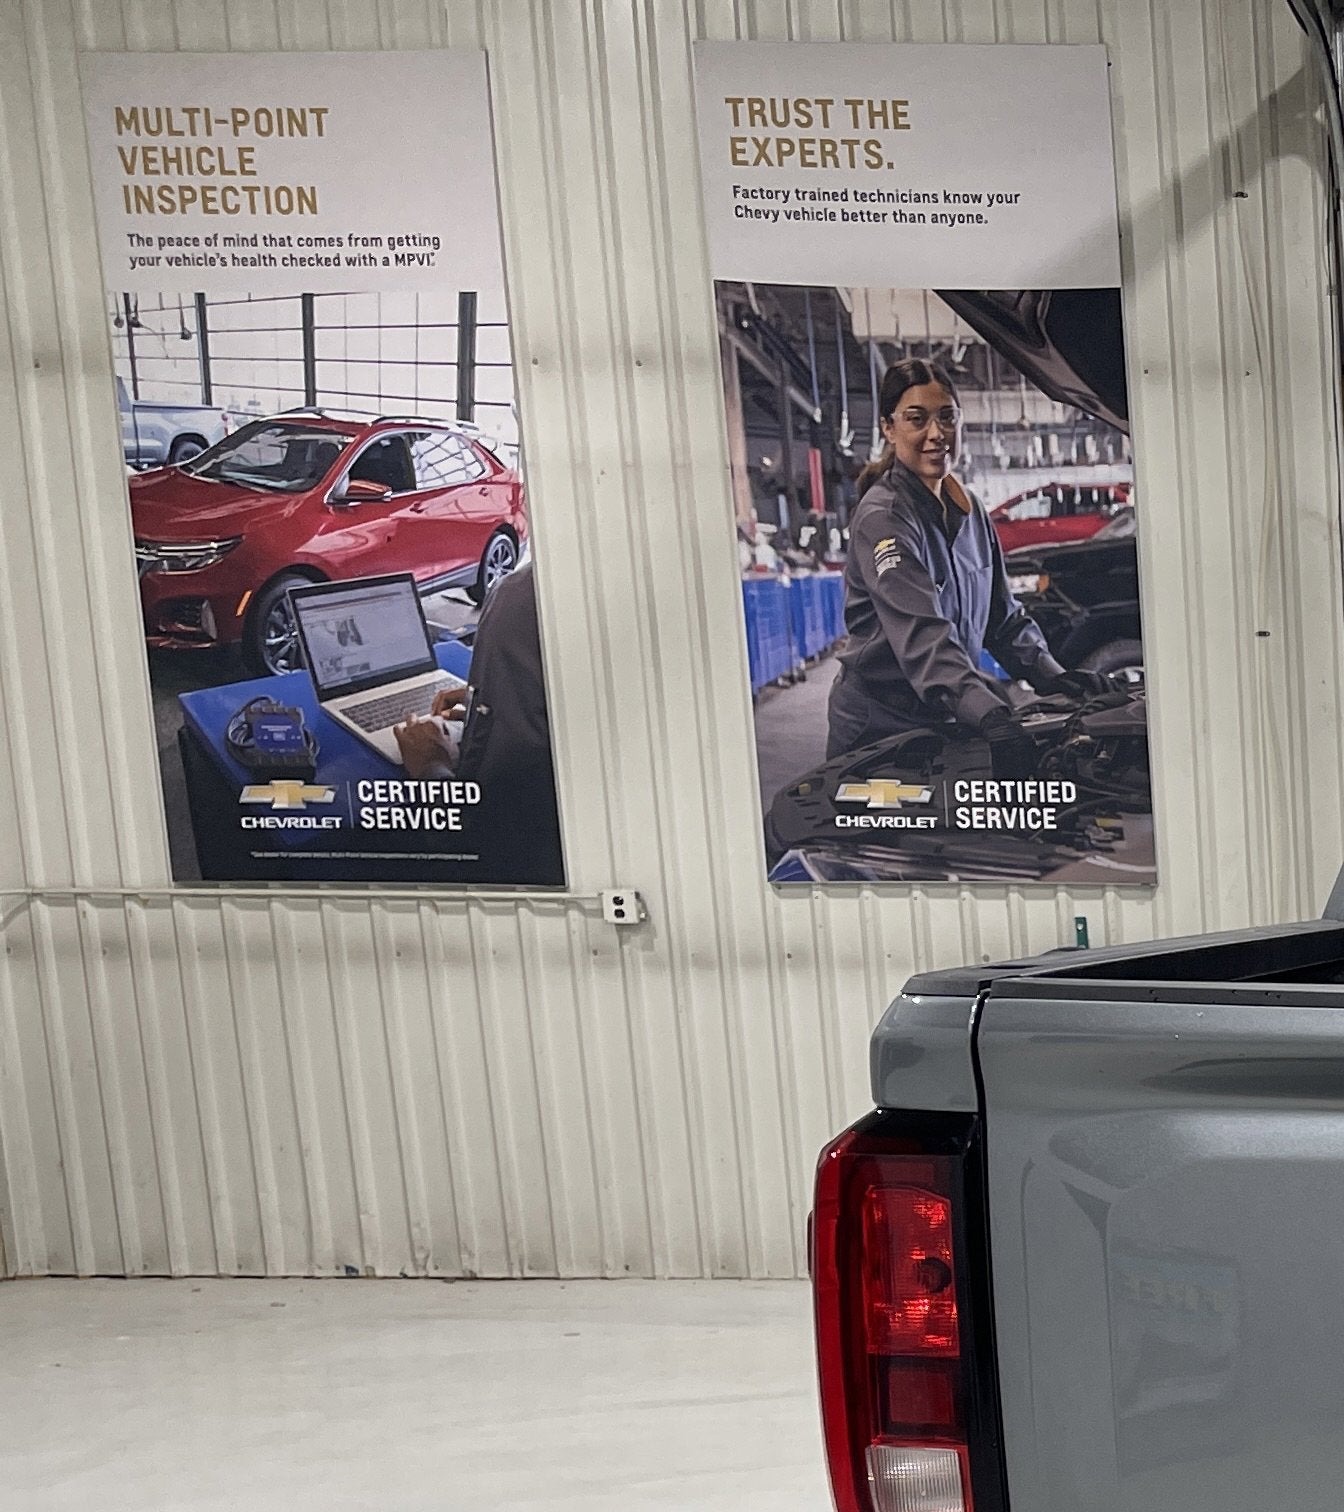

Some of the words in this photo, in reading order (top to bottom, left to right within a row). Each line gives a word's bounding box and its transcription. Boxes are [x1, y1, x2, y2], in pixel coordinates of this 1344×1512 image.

[115, 107, 329, 137] MULTI-POINT
[725, 98, 834, 129] TRUST
[844, 99, 911, 130] THE
[118, 146, 257, 176] VEHICLE
[730, 137, 895, 170] EXPERTS.
[124, 185, 319, 215] INSPECTION
[733, 185, 790, 203] Factory
[795, 187, 849, 202] trained
[853, 188, 939, 204] technicians
[943, 190, 983, 204] know
[986, 191, 1021, 206] your
[734, 205, 779, 223] Chevy
[784, 207, 837, 222] vehicle
[841, 208, 887, 223] better
[892, 209, 926, 224] than
[930, 212, 989, 227] anyone.
[127, 233, 154, 247] The
[158, 235, 200, 250] peace
[204, 233, 218, 247] of
[223, 233, 258, 247] mind
[262, 233, 293, 247] that
[297, 236, 344, 247] comes
[348, 233, 383, 247] from
[387, 233, 440, 250] getting
[129, 255, 161, 270] your
[165, 253, 227, 267] vehicle's
[231, 253, 277, 267] health
[281, 253, 341, 267] checked
[345, 253, 378, 267] with
[382, 256, 390, 267] a
[358, 780, 480, 805] CERTIFIED
[954, 780, 1076, 804] CERTIFIED
[241, 816, 343, 830] CHEVROLET
[360, 807, 463, 831] SERVICE
[835, 815, 938, 829] CHEVROLET
[956, 807, 1057, 830] SERVICE
